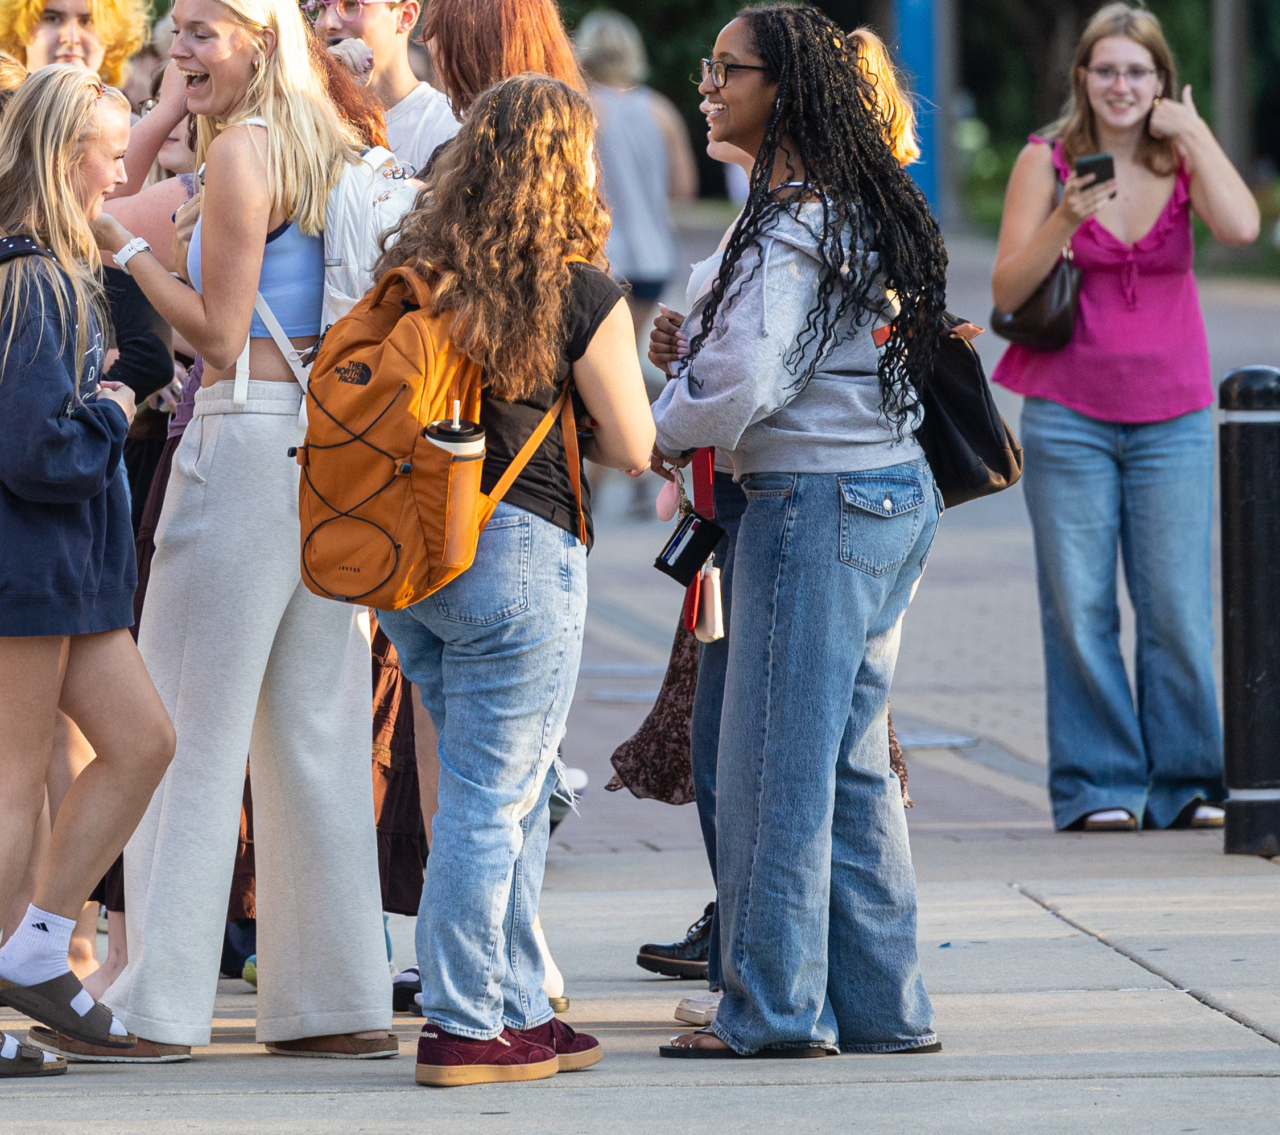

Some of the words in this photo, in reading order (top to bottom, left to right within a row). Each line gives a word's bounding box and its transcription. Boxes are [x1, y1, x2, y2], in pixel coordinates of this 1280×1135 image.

[348, 361, 363, 370] THE
[334, 366, 359, 377] NORTH
[338, 375, 360, 385] FACE
